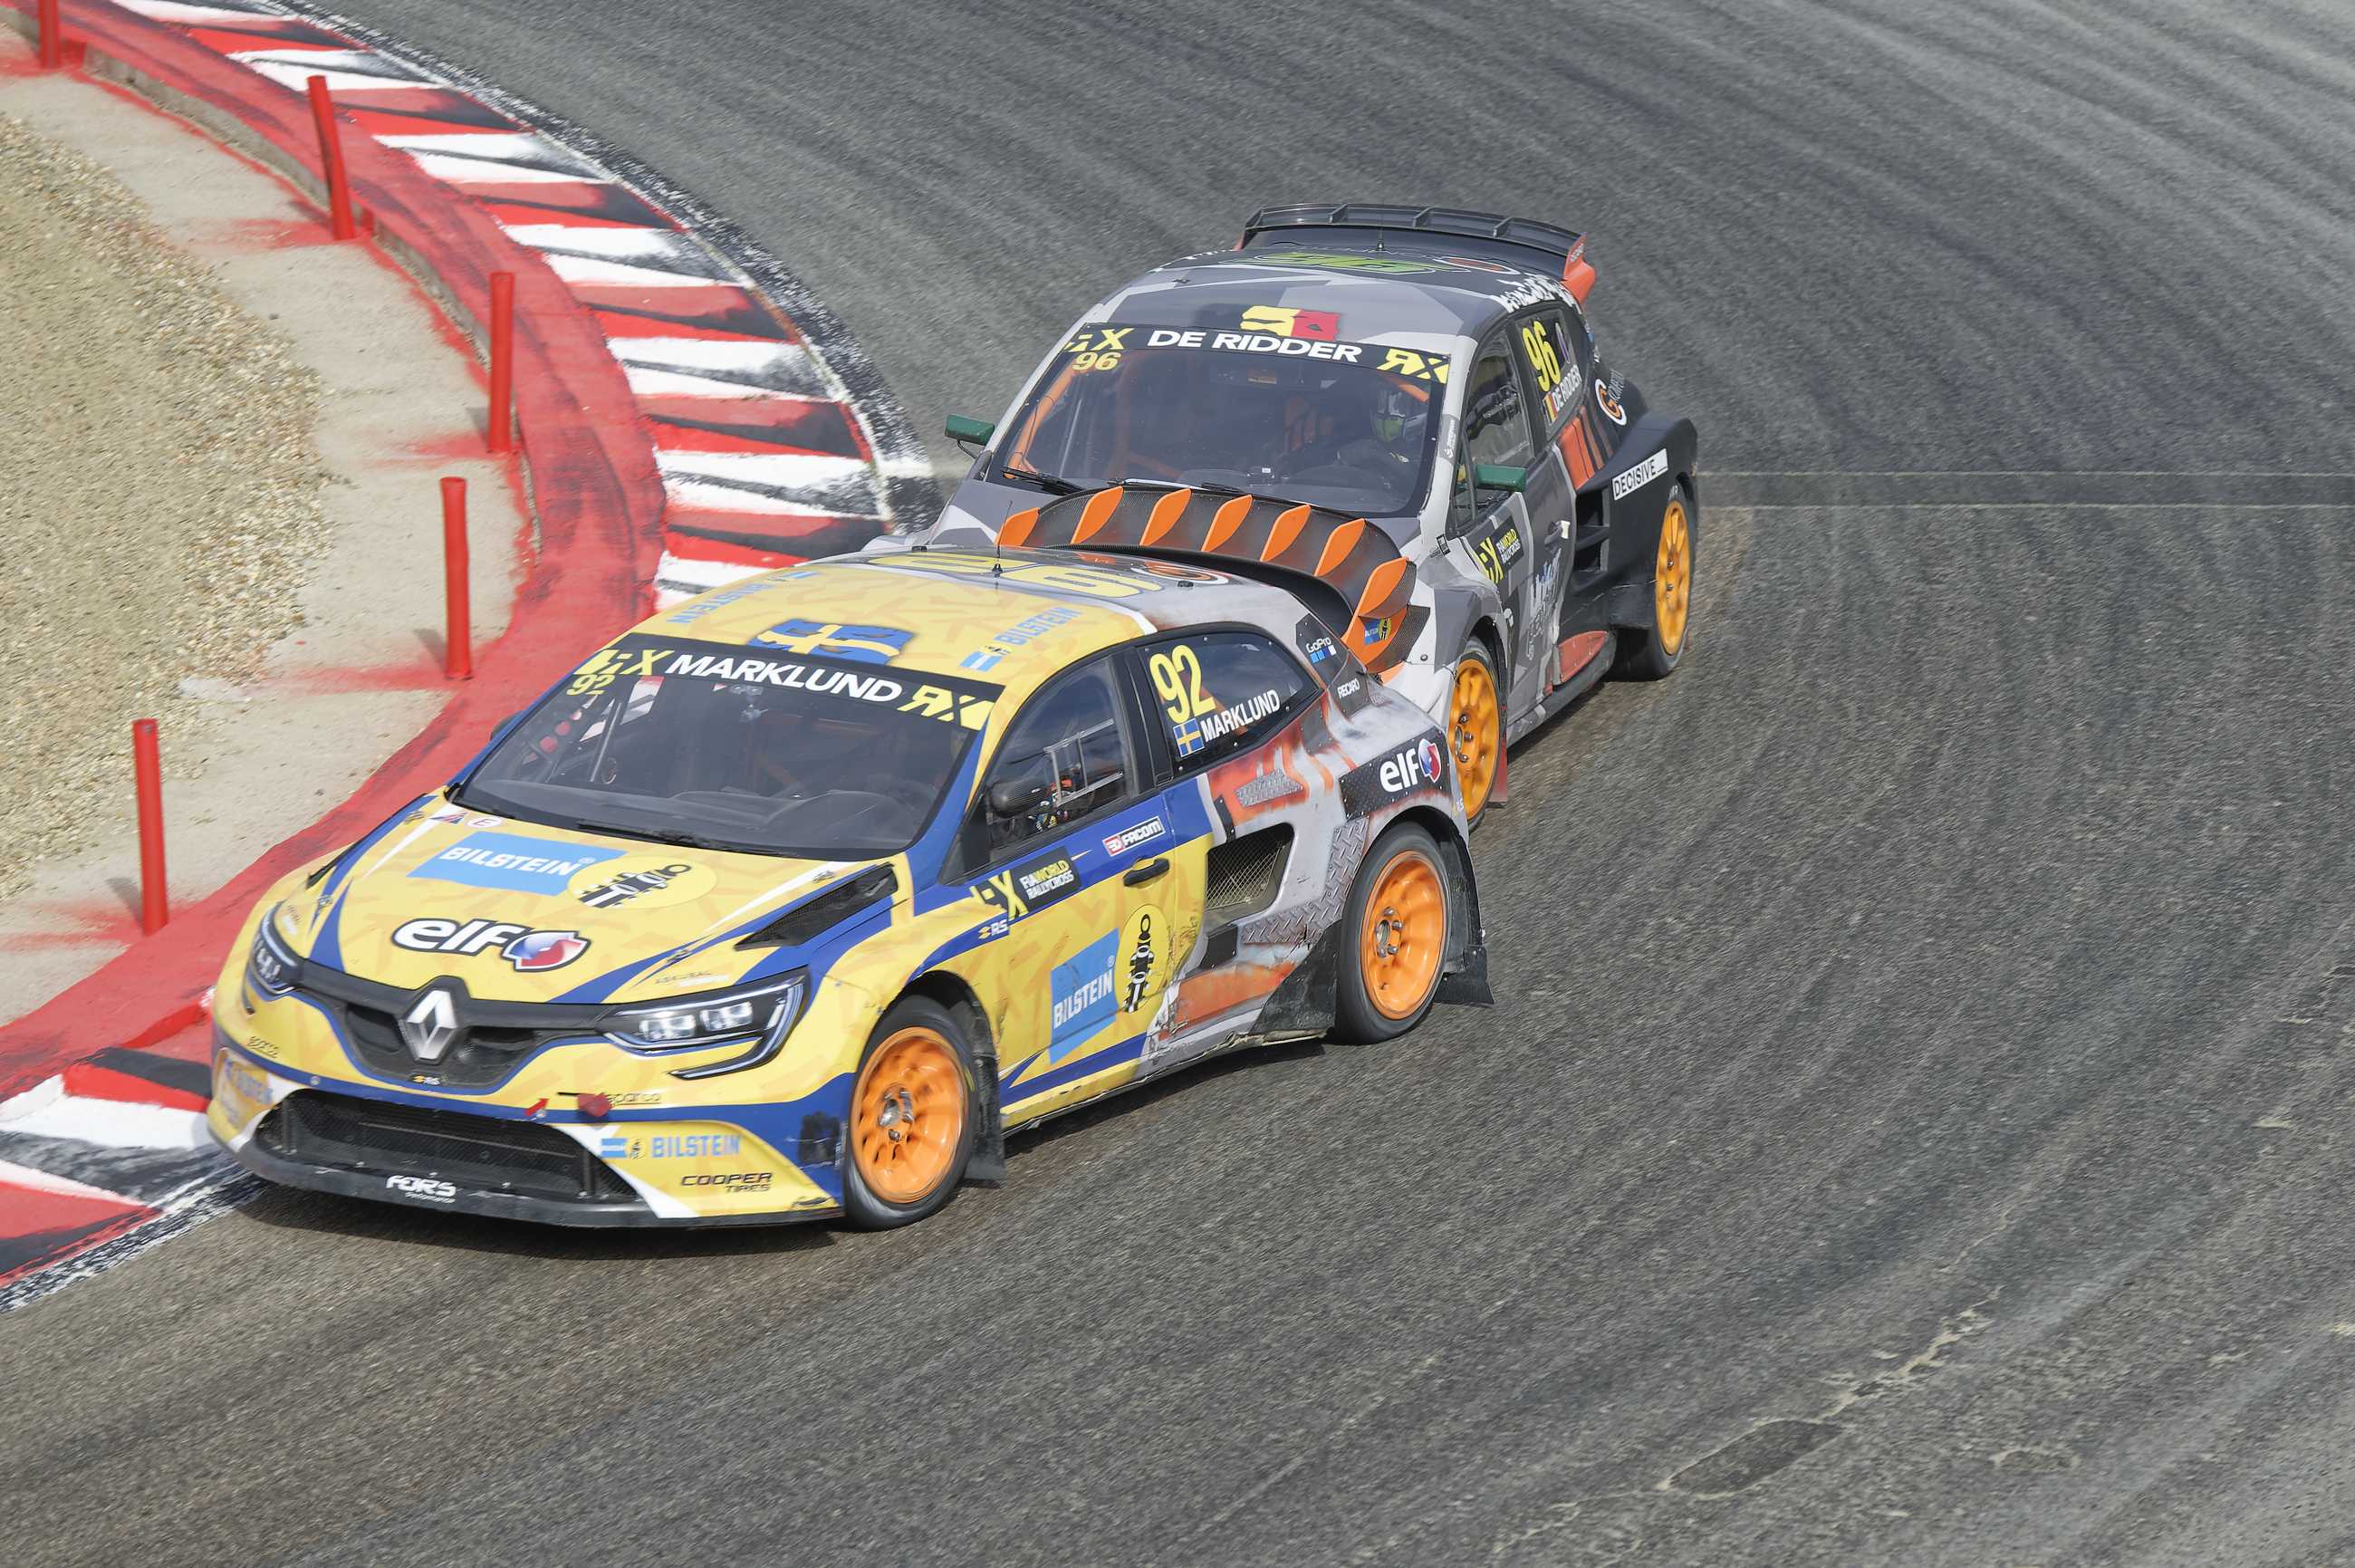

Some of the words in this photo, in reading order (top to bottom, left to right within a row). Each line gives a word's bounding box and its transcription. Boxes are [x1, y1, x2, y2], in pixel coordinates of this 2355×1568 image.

[1072, 351, 1121, 370] 96
[1148, 330, 1206, 348] DE
[1212, 333, 1362, 362] RIDDER
[1523, 321, 1562, 392] 96
[995, 606, 1081, 646] BILSTEIN
[1306, 637, 1332, 653] GoPro
[565, 674, 615, 696] 92
[665, 654, 902, 702] MARKLUND
[1149, 644, 1216, 724] 92
[1200, 689, 1281, 743] MARKLUND
[1379, 748, 1419, 793] elf
[439, 847, 581, 876] BILSTEIN
[395, 918, 524, 954] elf
[1053, 968, 1113, 1029] BILSTEIN
[652, 1135, 741, 1159] BILSTEIN
[681, 1173, 773, 1187] COOPER
[725, 1184, 770, 1193] TIRES
